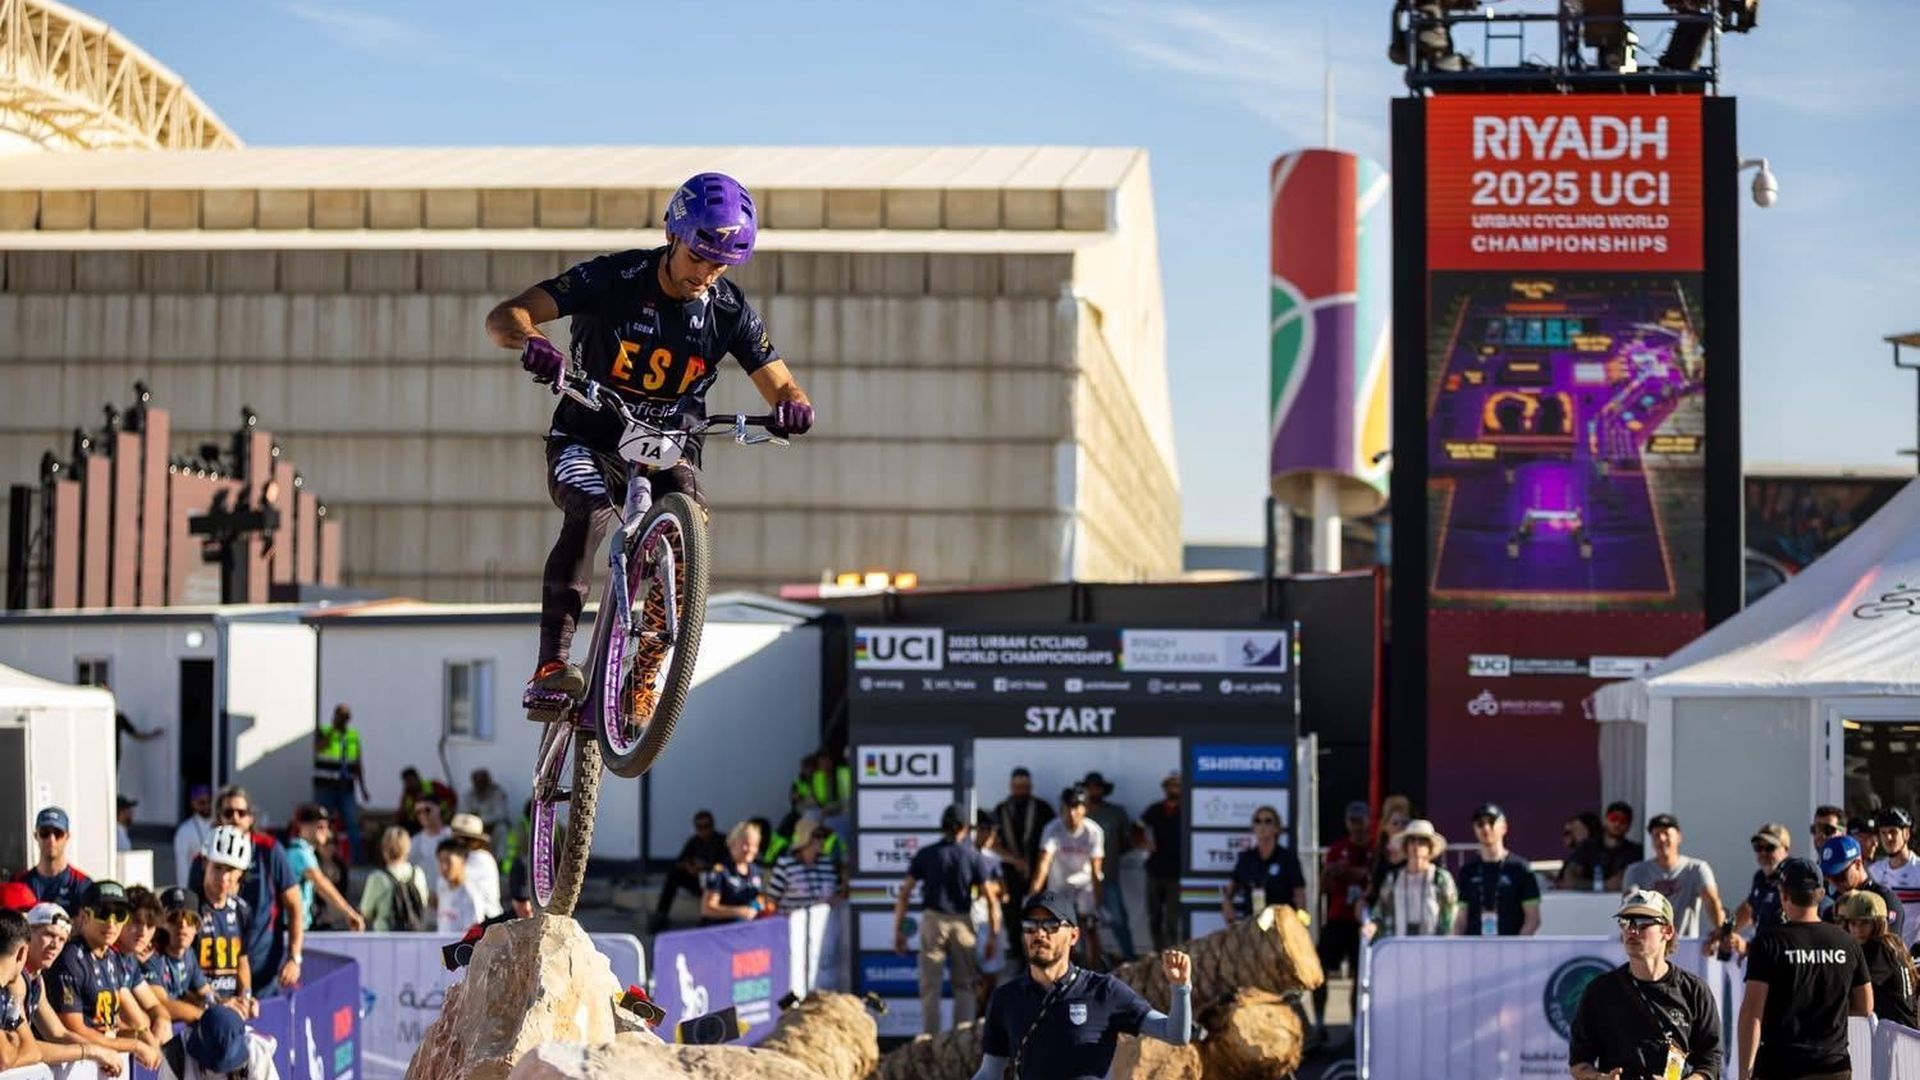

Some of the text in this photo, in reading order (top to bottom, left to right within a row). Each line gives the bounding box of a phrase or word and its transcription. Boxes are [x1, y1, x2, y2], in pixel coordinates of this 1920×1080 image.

[1472, 115, 1669, 160] RIYADH
[1471, 171, 1670, 206] 2025 UCI
[1471, 213, 1669, 229] URBAN CYCLING WORLD
[1471, 235, 1669, 252] CHAMPIONSHIPS
[640, 442, 661, 459] 1A
[872, 636, 935, 661] UCI
[950, 636, 1088, 649] 2025 URBAN CYCLING
[949, 651, 1114, 664] WORLD CHAMPIONSHIPS
[1025, 707, 1115, 732] START
[880, 753, 938, 776] UCI
[1198, 756, 1283, 771] SHIMANO
[875, 850, 912, 862] TISS
[1784, 949, 1847, 964] TIMING
